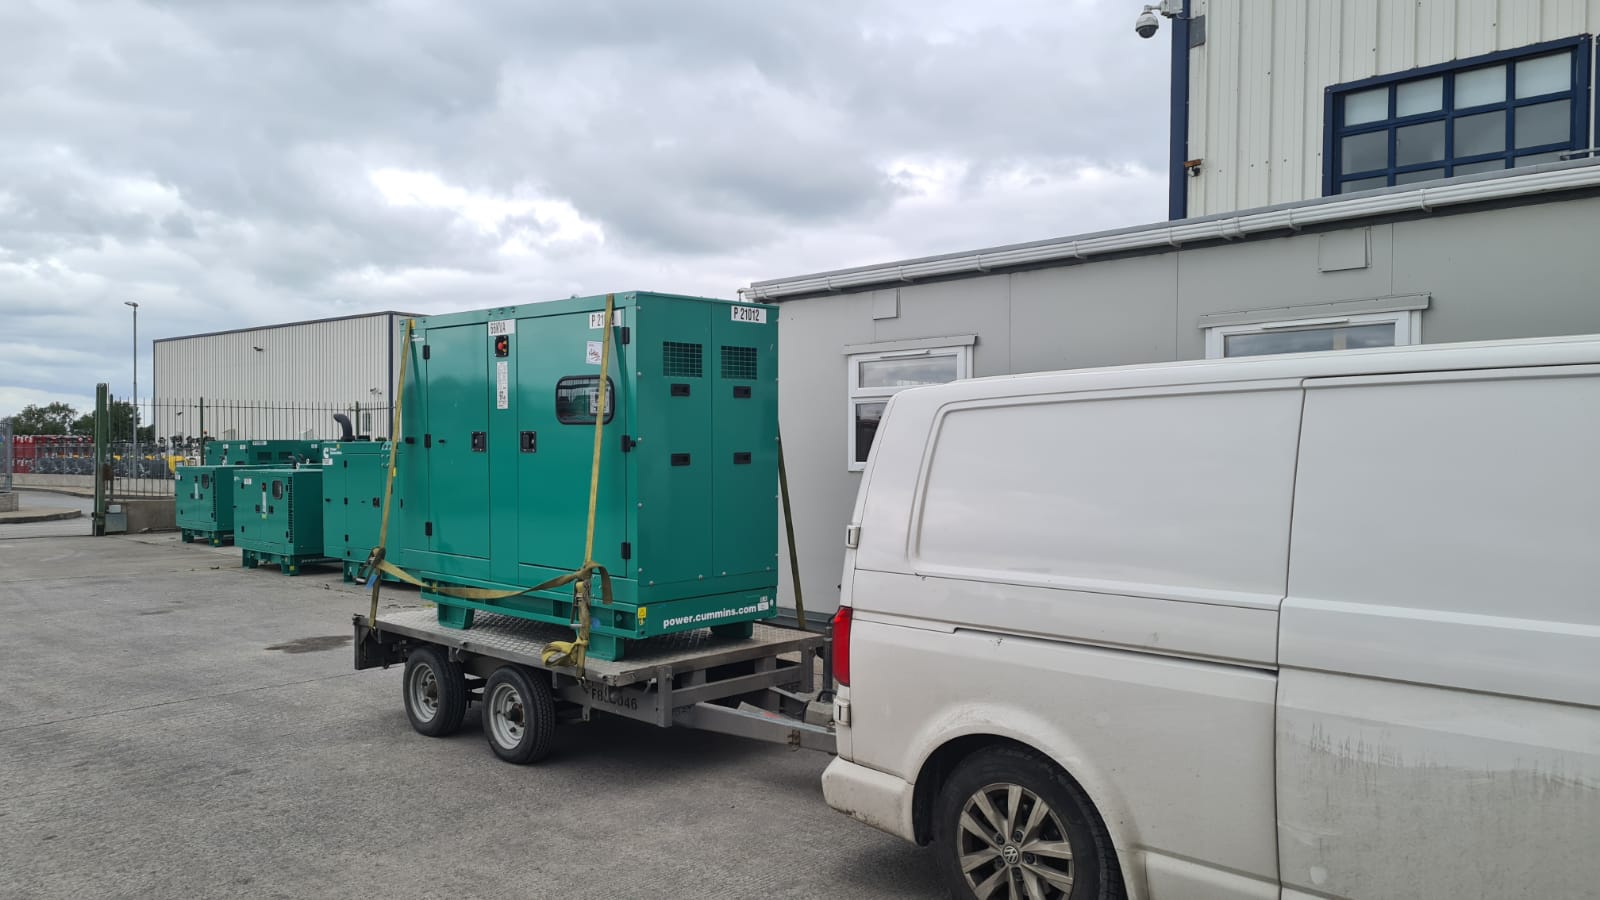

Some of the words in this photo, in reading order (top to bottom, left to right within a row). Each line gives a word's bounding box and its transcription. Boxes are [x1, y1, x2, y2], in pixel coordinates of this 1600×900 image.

[591, 313, 596, 328] P
[733, 306, 739, 319] P
[740, 307, 760, 322] 21012
[663, 605, 757, 629] power.cummins.com
